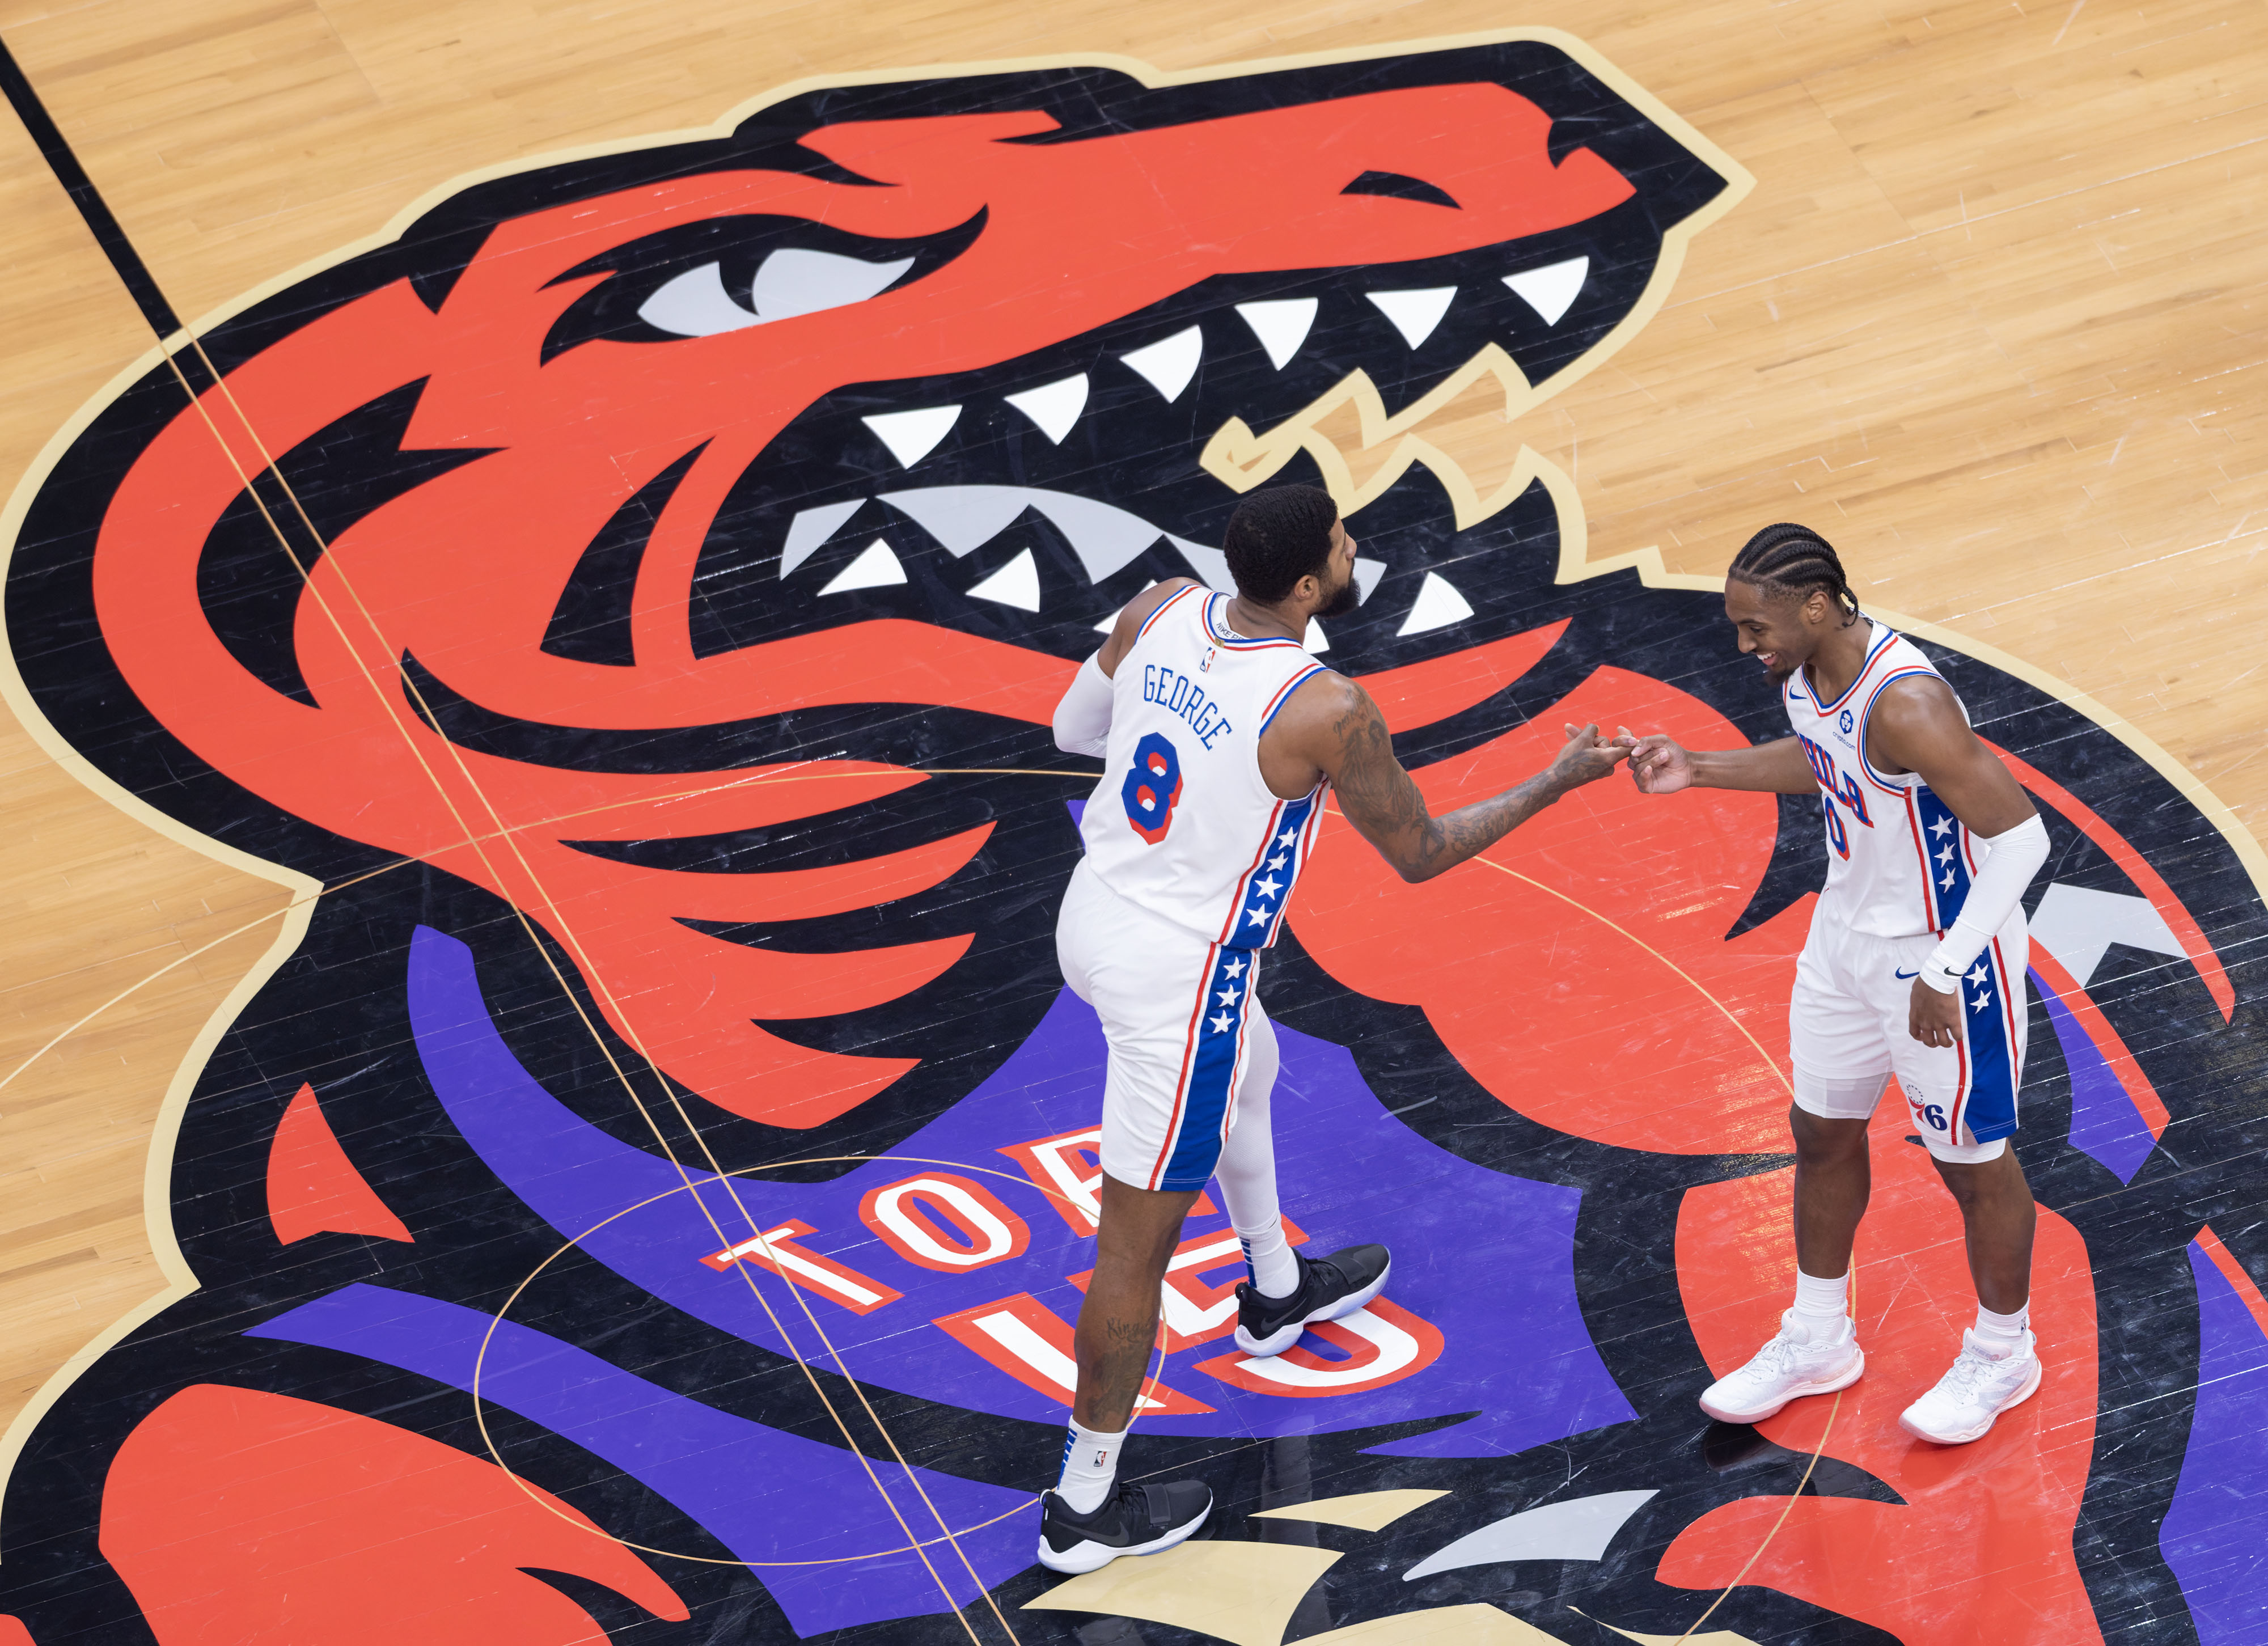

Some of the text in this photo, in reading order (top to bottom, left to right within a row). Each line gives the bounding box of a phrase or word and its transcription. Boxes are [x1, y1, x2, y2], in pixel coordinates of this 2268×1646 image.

[1216, 622, 1232, 637] NIKE
[1144, 664, 1232, 751] GEORGE
[1121, 731, 1184, 845] 8
[1797, 733, 1875, 828] HILA
[1825, 796, 1850, 861] 0
[1907, 1094, 1948, 1131] 76
